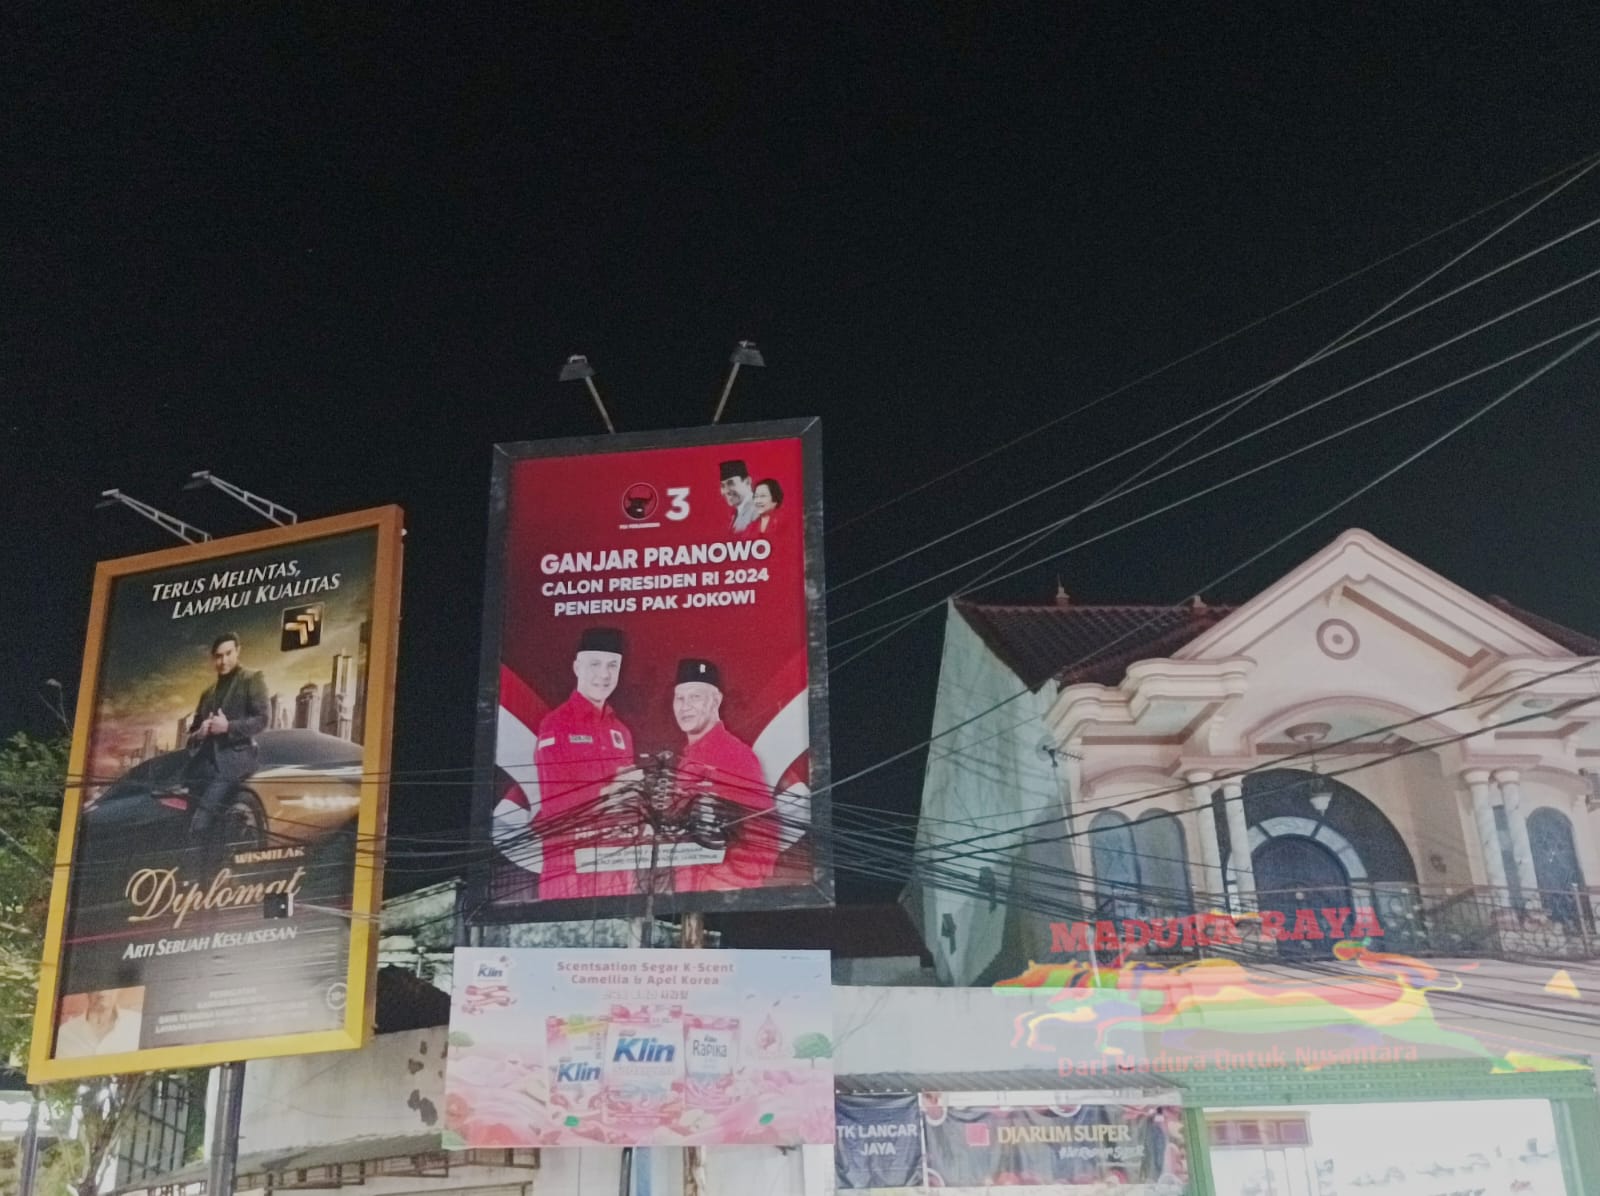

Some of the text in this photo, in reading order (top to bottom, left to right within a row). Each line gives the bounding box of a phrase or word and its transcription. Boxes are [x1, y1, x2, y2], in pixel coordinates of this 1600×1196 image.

[664, 486, 690, 521] 3
[540, 539, 771, 575] GANJAR PRANOWO
[152, 560, 301, 601] TERUS MELINTAS,
[541, 567, 769, 597] CALON PRESIDEN RI 2024
[171, 573, 341, 619] LAMPAUI KUALITAS
[554, 589, 755, 617] PENERUS PAK JOKOWI
[235, 846, 305, 864] WISMILAK
[125, 866, 306, 928] Diplomat
[1049, 906, 1385, 953] MADURA RAYA
[122, 925, 298, 960] ARTI SEBUAH KESUKSESAN
[477, 967, 503, 977] Klin
[556, 961, 736, 974] Scentsation Segar K-Scent
[570, 974, 629, 985] Camellia
[646, 975, 677, 987] Apel
[680, 975, 719, 985] Korea
[613, 1036, 676, 1063] Klin
[692, 1039, 728, 1058] Rapika
[557, 1061, 601, 1083] Klin
[1057, 1054, 1109, 1077] Dari
[836, 1123, 918, 1139] TK LANCAR
[998, 1123, 1131, 1144] DJARUM SUPER
[860, 1142, 897, 1156] JAYA
